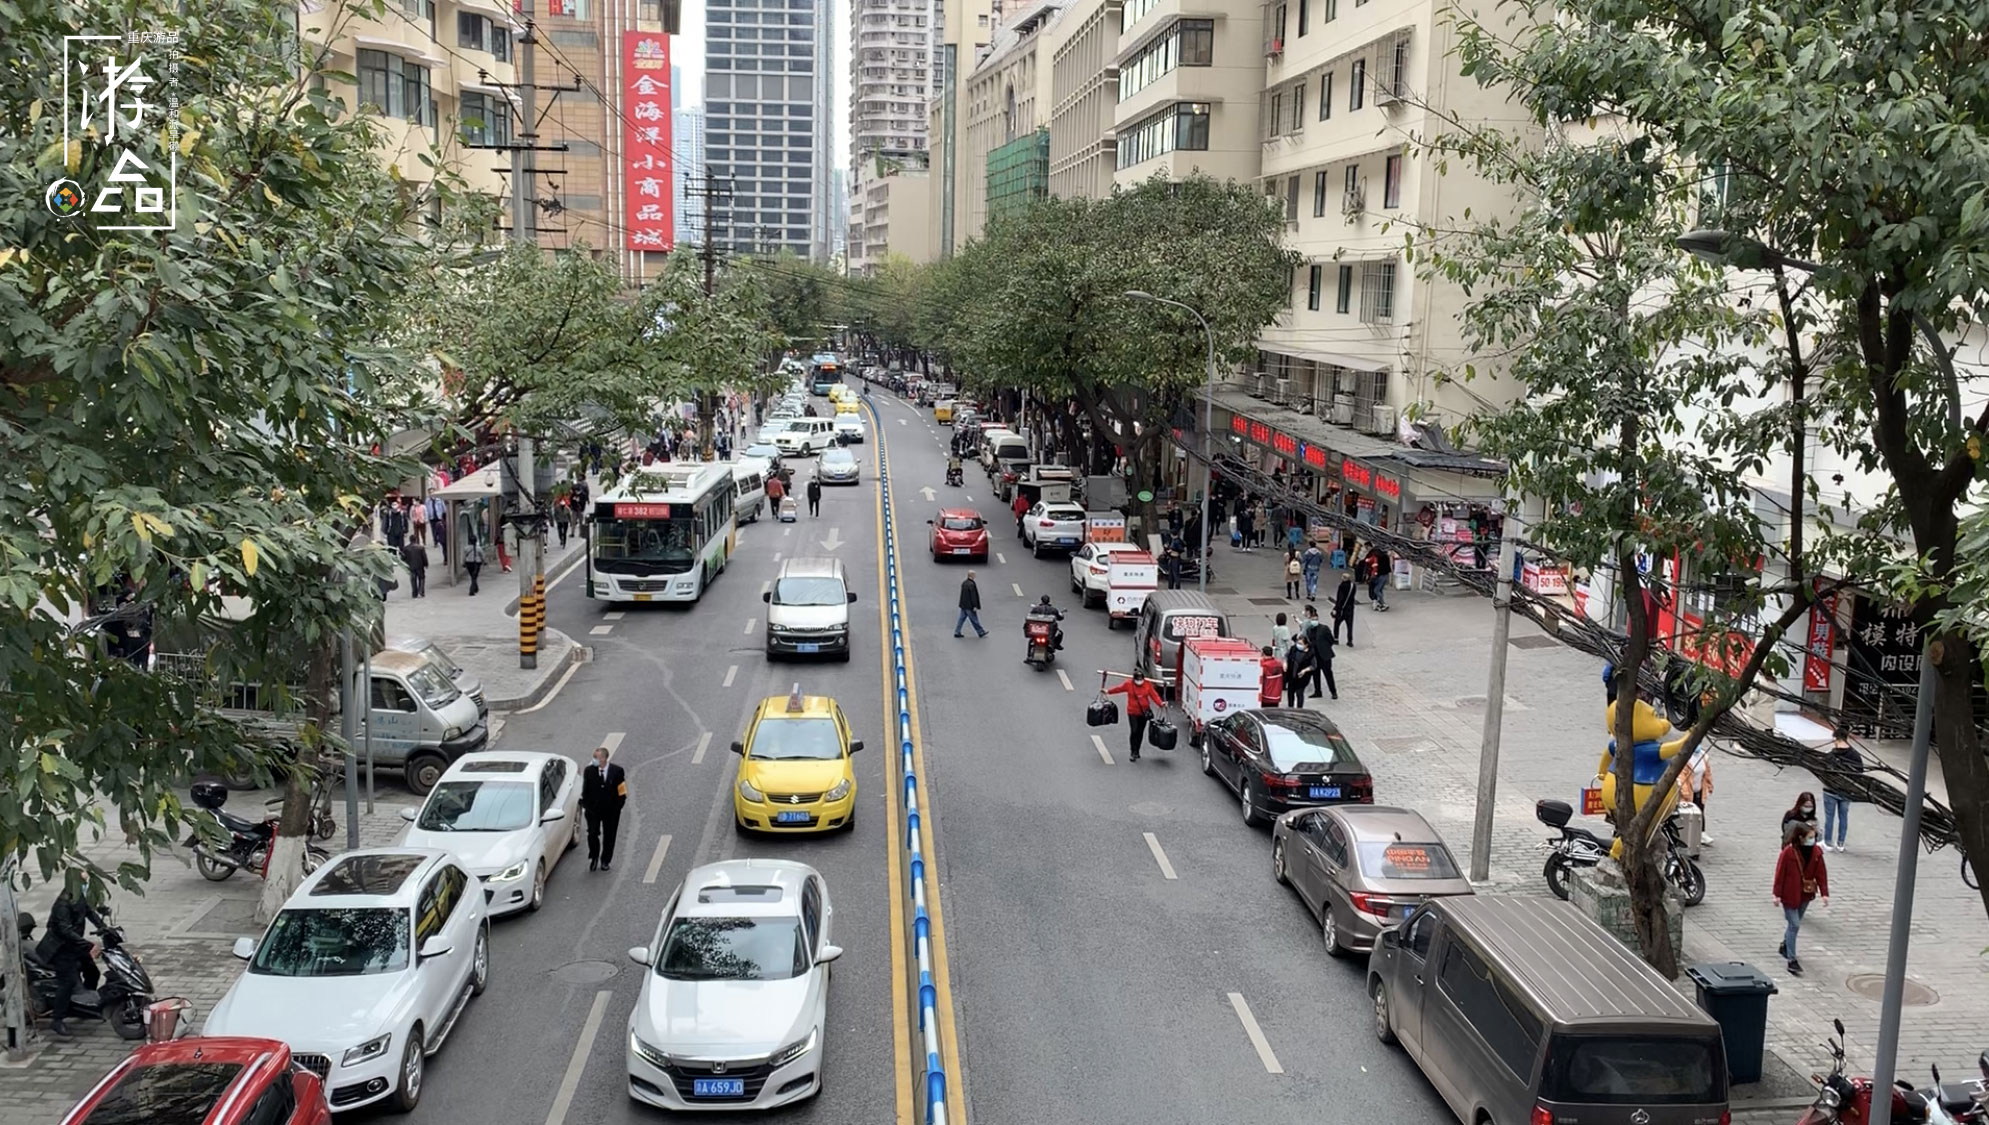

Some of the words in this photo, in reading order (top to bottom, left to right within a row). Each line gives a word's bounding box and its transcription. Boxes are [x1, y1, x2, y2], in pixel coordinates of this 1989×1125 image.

[630, 74, 670, 249] 金海洋小商品城
[1172, 617, 1218, 629] 快狗打车
[1860, 621, 1918, 647] 模特
